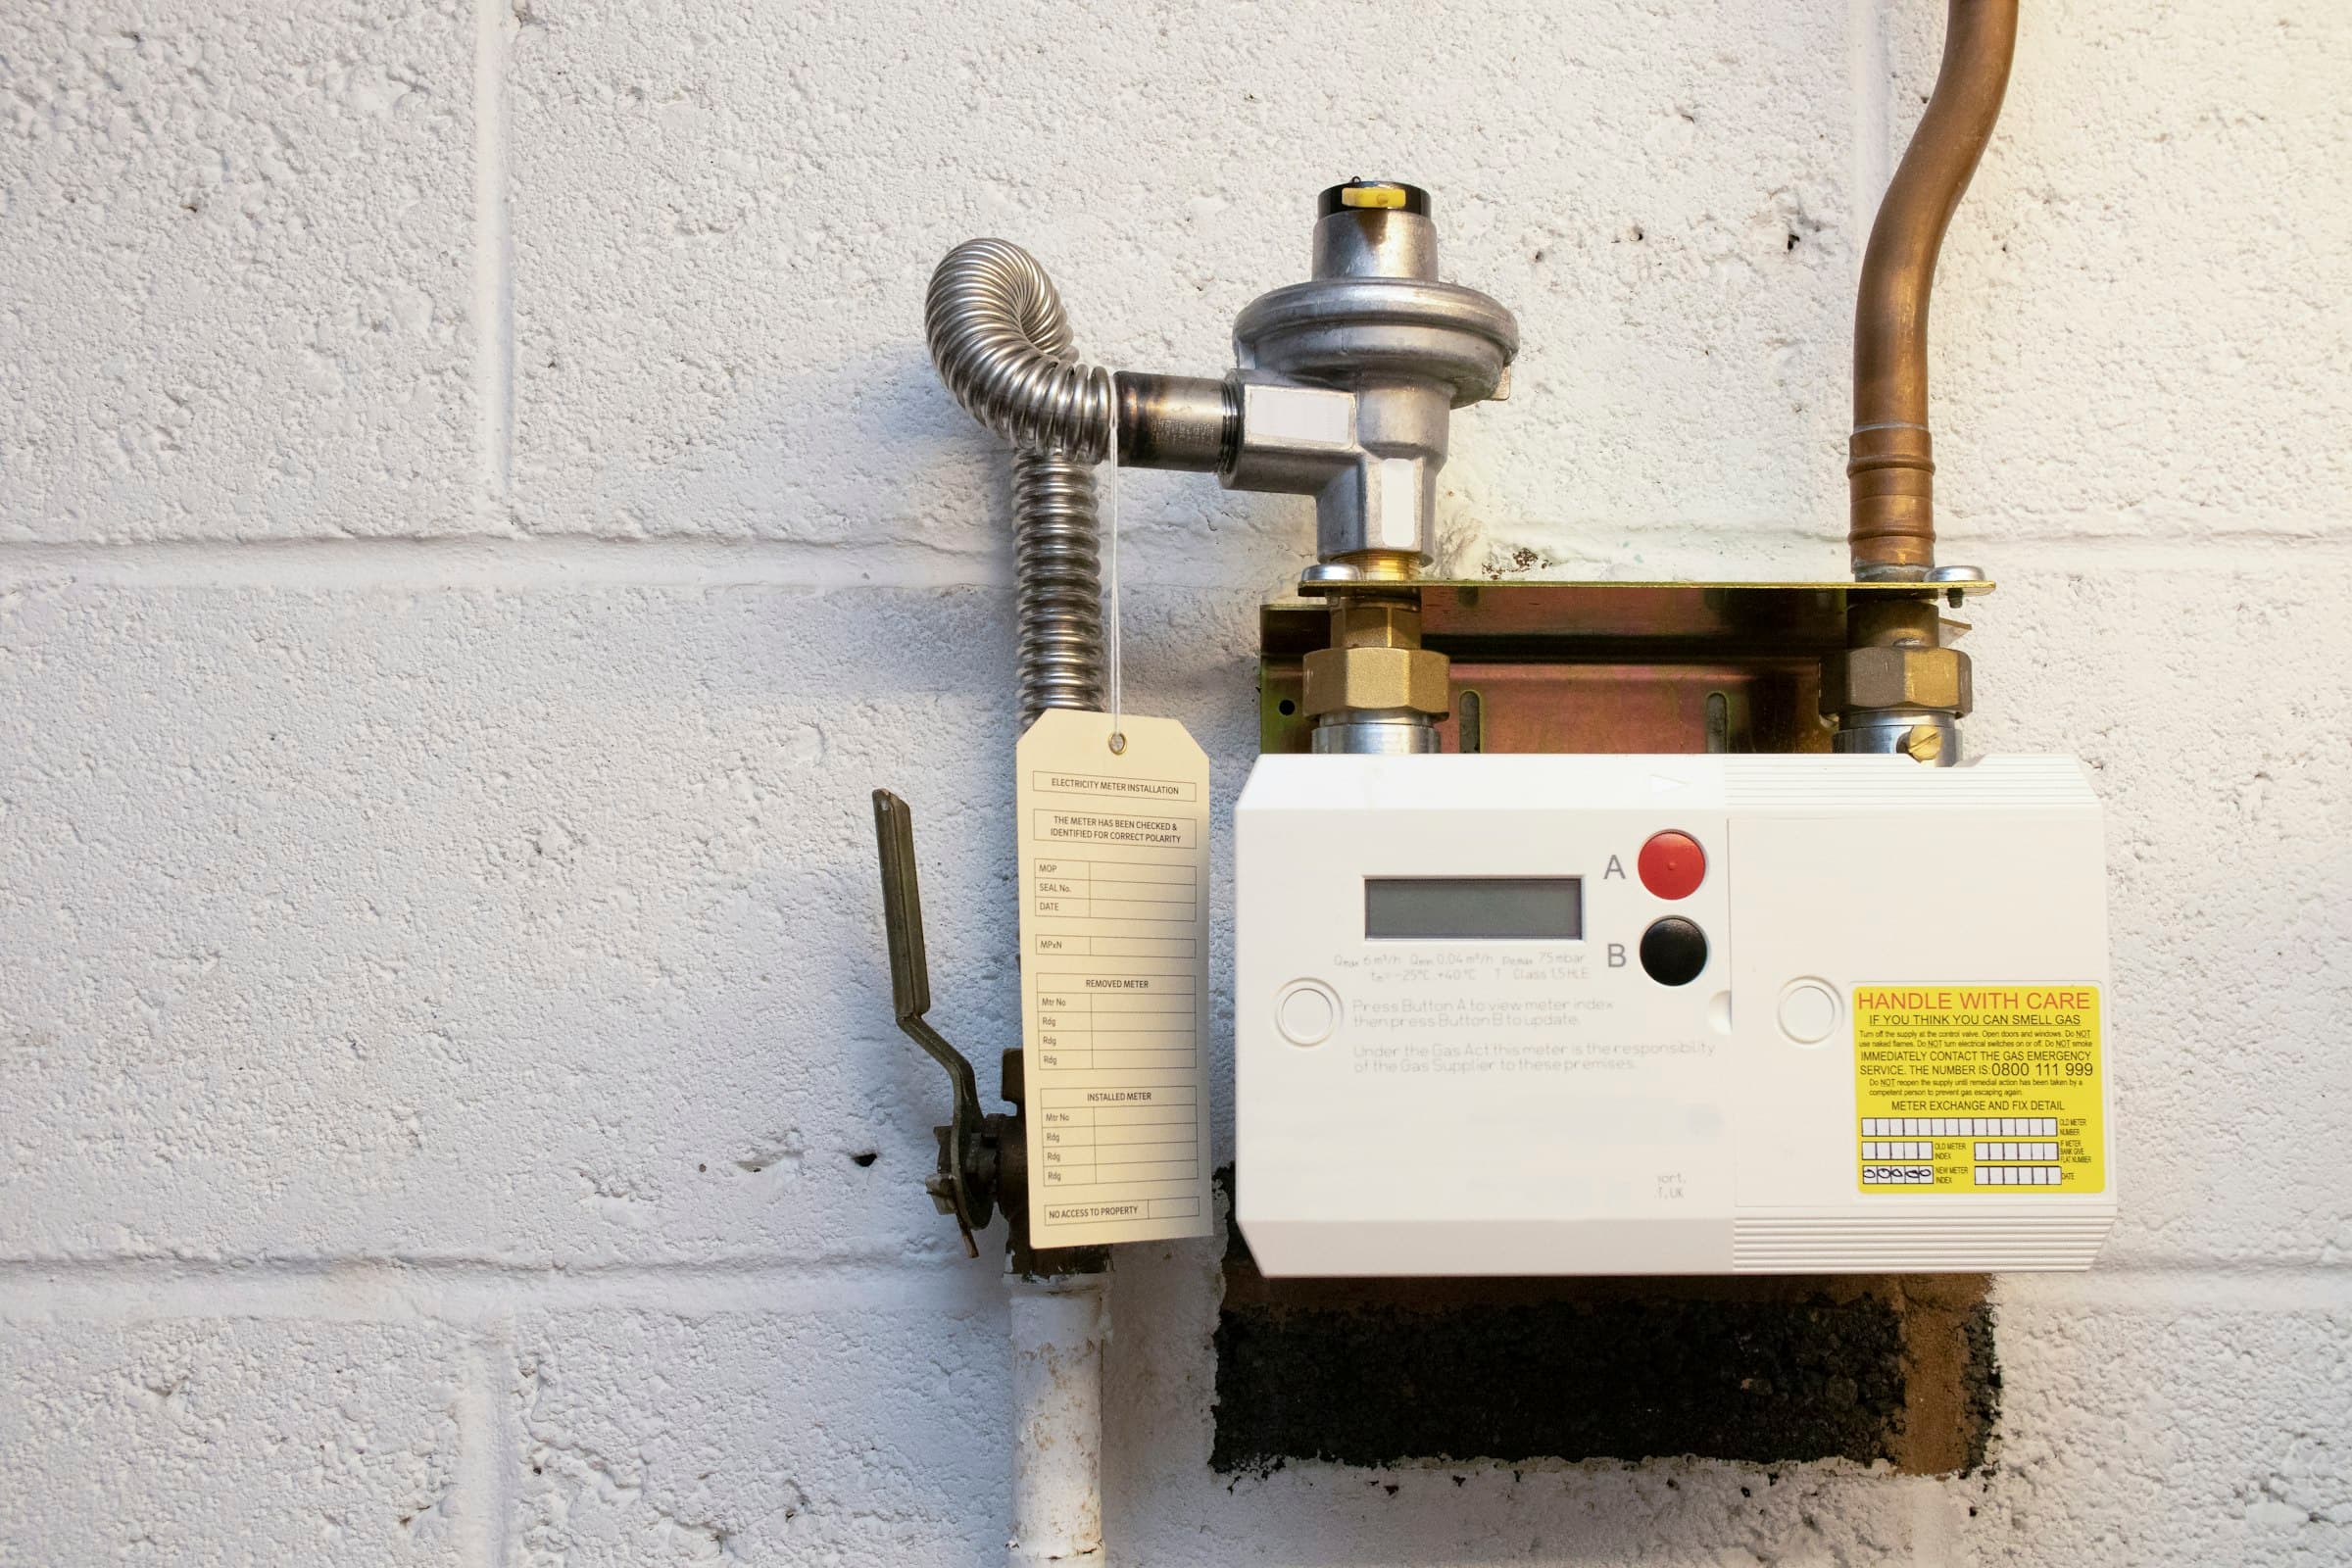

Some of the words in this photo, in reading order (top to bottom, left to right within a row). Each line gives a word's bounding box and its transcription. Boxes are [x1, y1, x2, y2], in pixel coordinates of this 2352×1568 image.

[1052, 778, 1099, 789] ELECTRICITY
[1100, 782, 1127, 791] METER
[1127, 784, 1179, 795] INSTALLATION
[1054, 815, 1068, 824] THE
[1070, 817, 1097, 826] METER
[1115, 820, 1135, 829] BEEN
[1136, 821, 1171, 831] CHECKED
[1051, 828, 1093, 839] IDENTIFIED
[1094, 830, 1108, 840] FOR
[1109, 831, 1144, 842] CORRECT
[1145, 833, 1181, 844] POLARITY
[1039, 864, 1057, 873] MOP
[1603, 854, 1627, 880] A
[1039, 883, 1057, 893] SEAL
[1059, 884, 1072, 893] No.
[1039, 902, 1059, 911] DATE
[1040, 940, 1062, 950] MPxN
[1607, 943, 1627, 968] B
[1086, 979, 1122, 988] REMOVED
[1123, 980, 1150, 989] METER
[1042, 998, 1054, 1006] Mtr
[1055, 998, 1066, 1006] No
[1351, 998, 1398, 1012] Press
[1401, 998, 1454, 1012] Button
[1457, 998, 1466, 1010] A
[1470, 998, 1485, 1012] to
[1489, 999, 1522, 1011] view
[1524, 999, 1570, 1011] meter
[1573, 998, 1614, 1011] index
[1858, 992, 1953, 1010] HANDLE
[1959, 992, 2019, 1010] WITH
[2026, 992, 2091, 1010] CARE
[1042, 1016, 1056, 1027] Rdg
[1353, 1013, 1389, 1028] then
[1391, 1016, 1436, 1033] press
[1438, 1012, 1490, 1028] Button
[1492, 1012, 1503, 1027] B
[1506, 1012, 1522, 1027] to
[1869, 1014, 1881, 1026] IF
[1883, 1014, 1910, 1026] YOU
[1912, 1014, 1950, 1026] THINK
[1952, 1014, 1980, 1026] YOU
[1983, 1014, 2009, 1026] CAN
[2012, 1014, 2053, 1026] SMELL
[2055, 1014, 2082, 1026] GAS
[1896, 1030, 1918, 1040] supply
[1982, 1030, 1999, 1039] Open
[2076, 1030, 2091, 1039] NOT
[1043, 1036, 1057, 1046] Rdg
[1928, 1040, 1942, 1049] NOT
[2055, 1040, 2071, 1049] NOT
[1353, 1043, 1399, 1058] Under
[1403, 1043, 1430, 1057] the
[1433, 1043, 1461, 1057] Gas
[1465, 1042, 1490, 1056] Act
[1493, 1042, 1521, 1056] this
[1521, 1043, 1569, 1056] meter
[1571, 1043, 1584, 1055] is
[1586, 1042, 1612, 1055] the
[1043, 1055, 1057, 1065] Rdg
[1860, 1051, 1928, 1061] IMMEDIATELY
[1930, 1051, 1978, 1061] CONTACT
[1980, 1051, 2000, 1061] THE
[2003, 1051, 2025, 1061] GAS
[2027, 1051, 2092, 1061] EMERGENCY
[1859, 1064, 1906, 1075] SERVICE.
[1909, 1064, 1930, 1075] THE
[1932, 1064, 1976, 1075] NUMBER
[1979, 1064, 1991, 1075] IS:
[1991, 1062, 2030, 1076] 0800
[2035, 1062, 2058, 1076] 111
[2065, 1062, 2093, 1076] 999
[1933, 1079, 1953, 1088] supply
[2069, 1079, 2078, 1088] by
[1087, 1092, 1126, 1102] INSTALLED
[1126, 1092, 1152, 1102] METER
[1891, 1101, 1928, 1111] METER
[1929, 1101, 1986, 1111] EXCHANGE
[1987, 1101, 2010, 1111] AND
[2012, 1101, 2029, 1111] FIX
[2031, 1101, 2066, 1111] DETAIL
[1046, 1113, 1058, 1122] Mtr
[1059, 1112, 1070, 1121] No
[1046, 1133, 1060, 1143] Rdg
[1934, 1142, 1946, 1151] OLD
[1946, 1142, 1967, 1151] METER
[1047, 1152, 1060, 1162] Rdg
[1048, 1171, 1061, 1182] Rdg
[1049, 1210, 1059, 1219] NO
[1060, 1208, 1089, 1218] ACCESS
[1090, 1207, 1100, 1217] TO
[1101, 1205, 1139, 1216] PROPERTY
